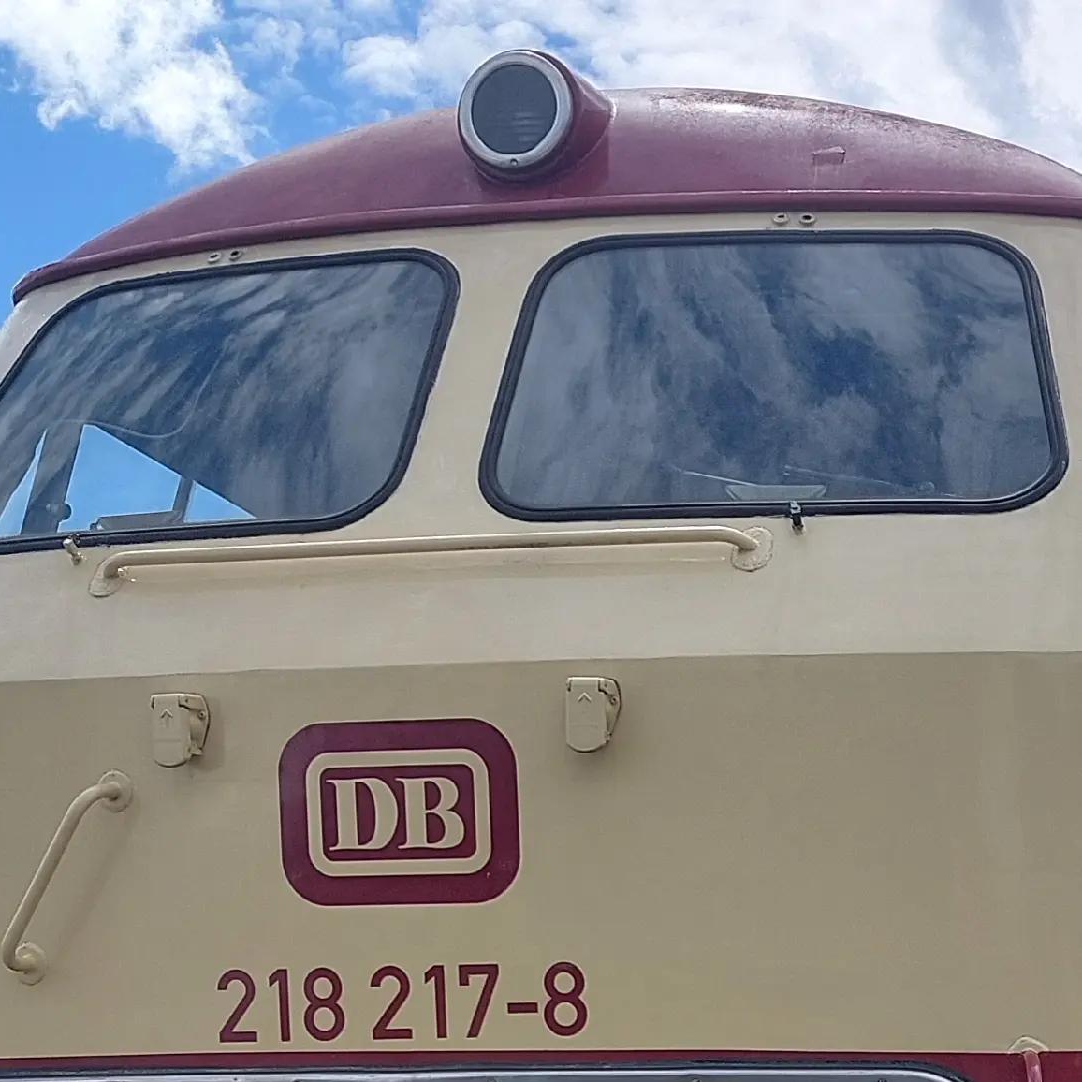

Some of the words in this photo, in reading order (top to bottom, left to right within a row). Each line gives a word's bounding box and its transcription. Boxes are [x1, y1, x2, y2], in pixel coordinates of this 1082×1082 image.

[325, 776, 466, 852] DB
[217, 967, 346, 1044] 218
[370, 961, 589, 1040] 217-8
